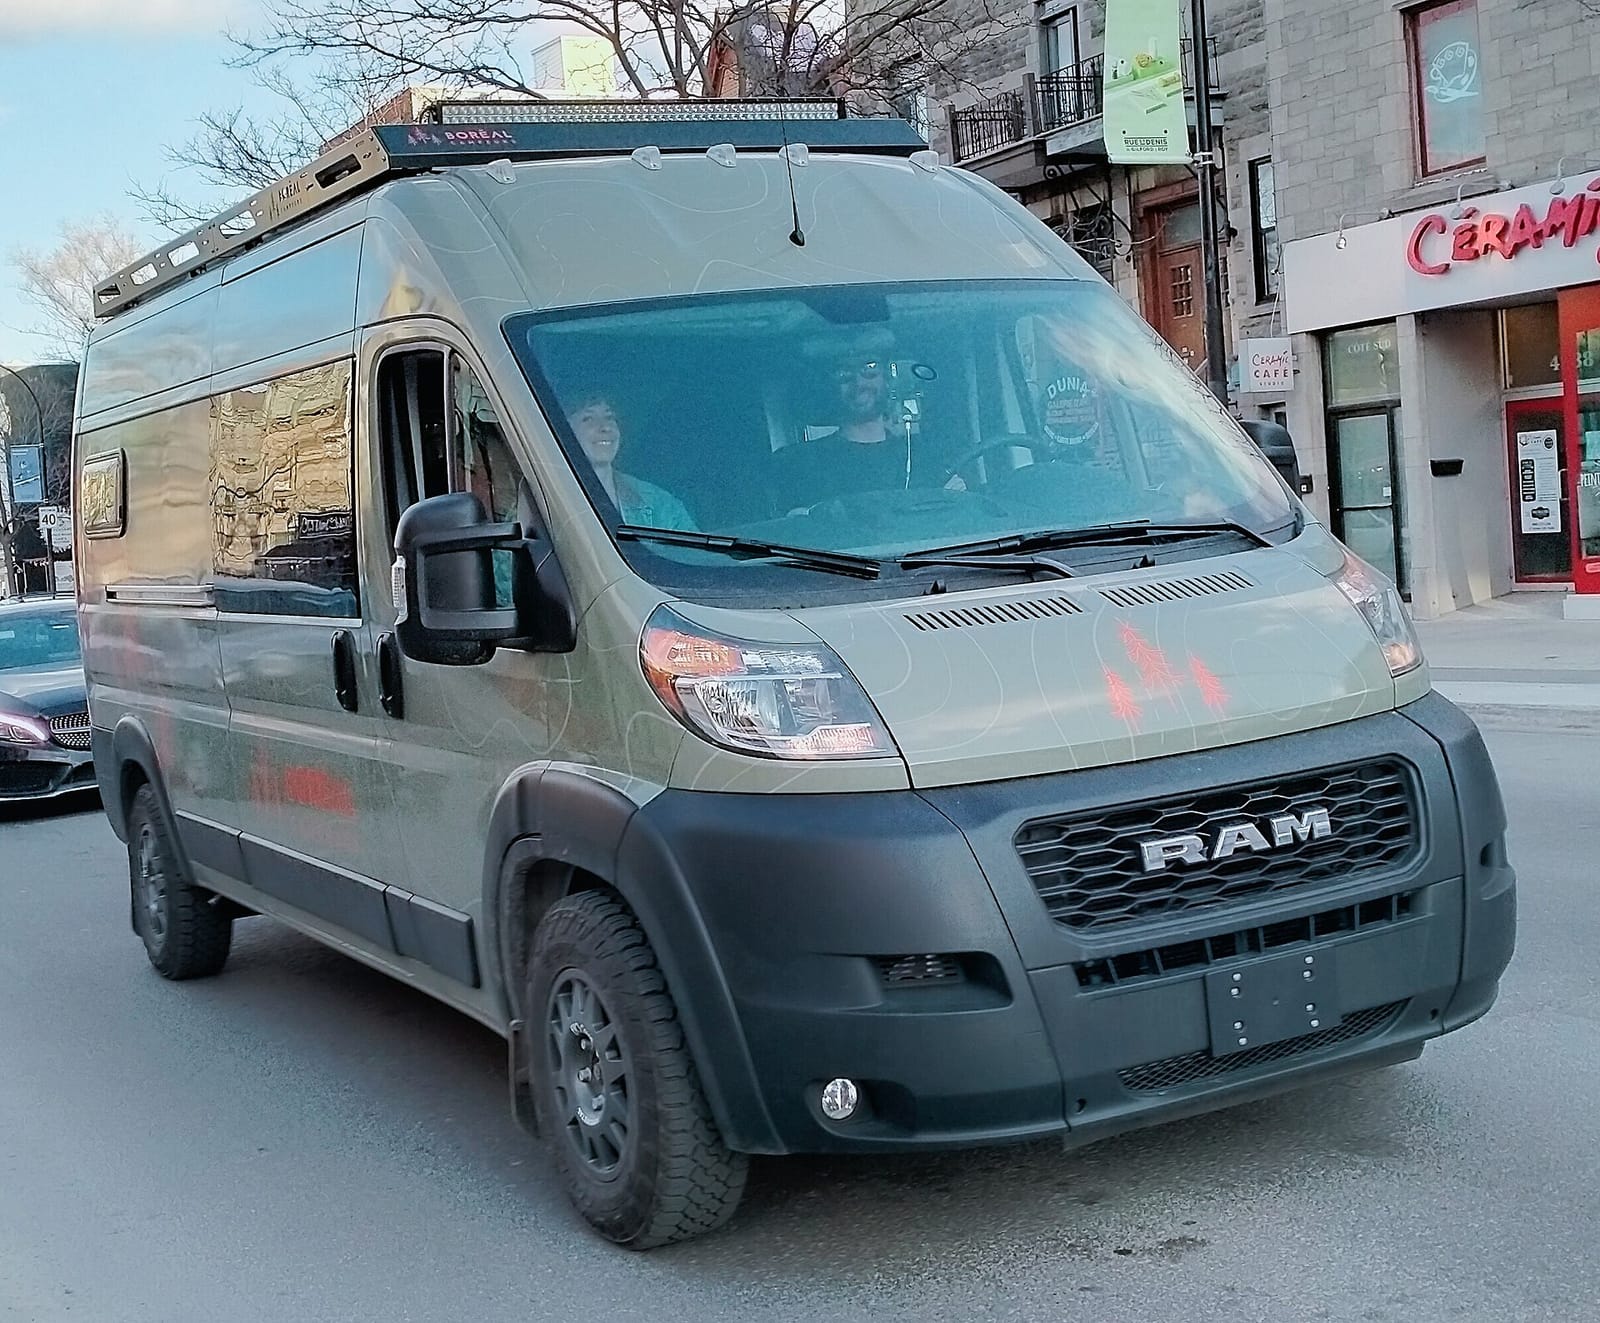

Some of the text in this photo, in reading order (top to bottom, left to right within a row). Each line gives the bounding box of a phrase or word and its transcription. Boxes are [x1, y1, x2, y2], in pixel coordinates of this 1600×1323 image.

[444, 129, 513, 140] BORÉAL
[41, 514, 56, 525] 40
[1139, 805, 1333, 872] RAM
